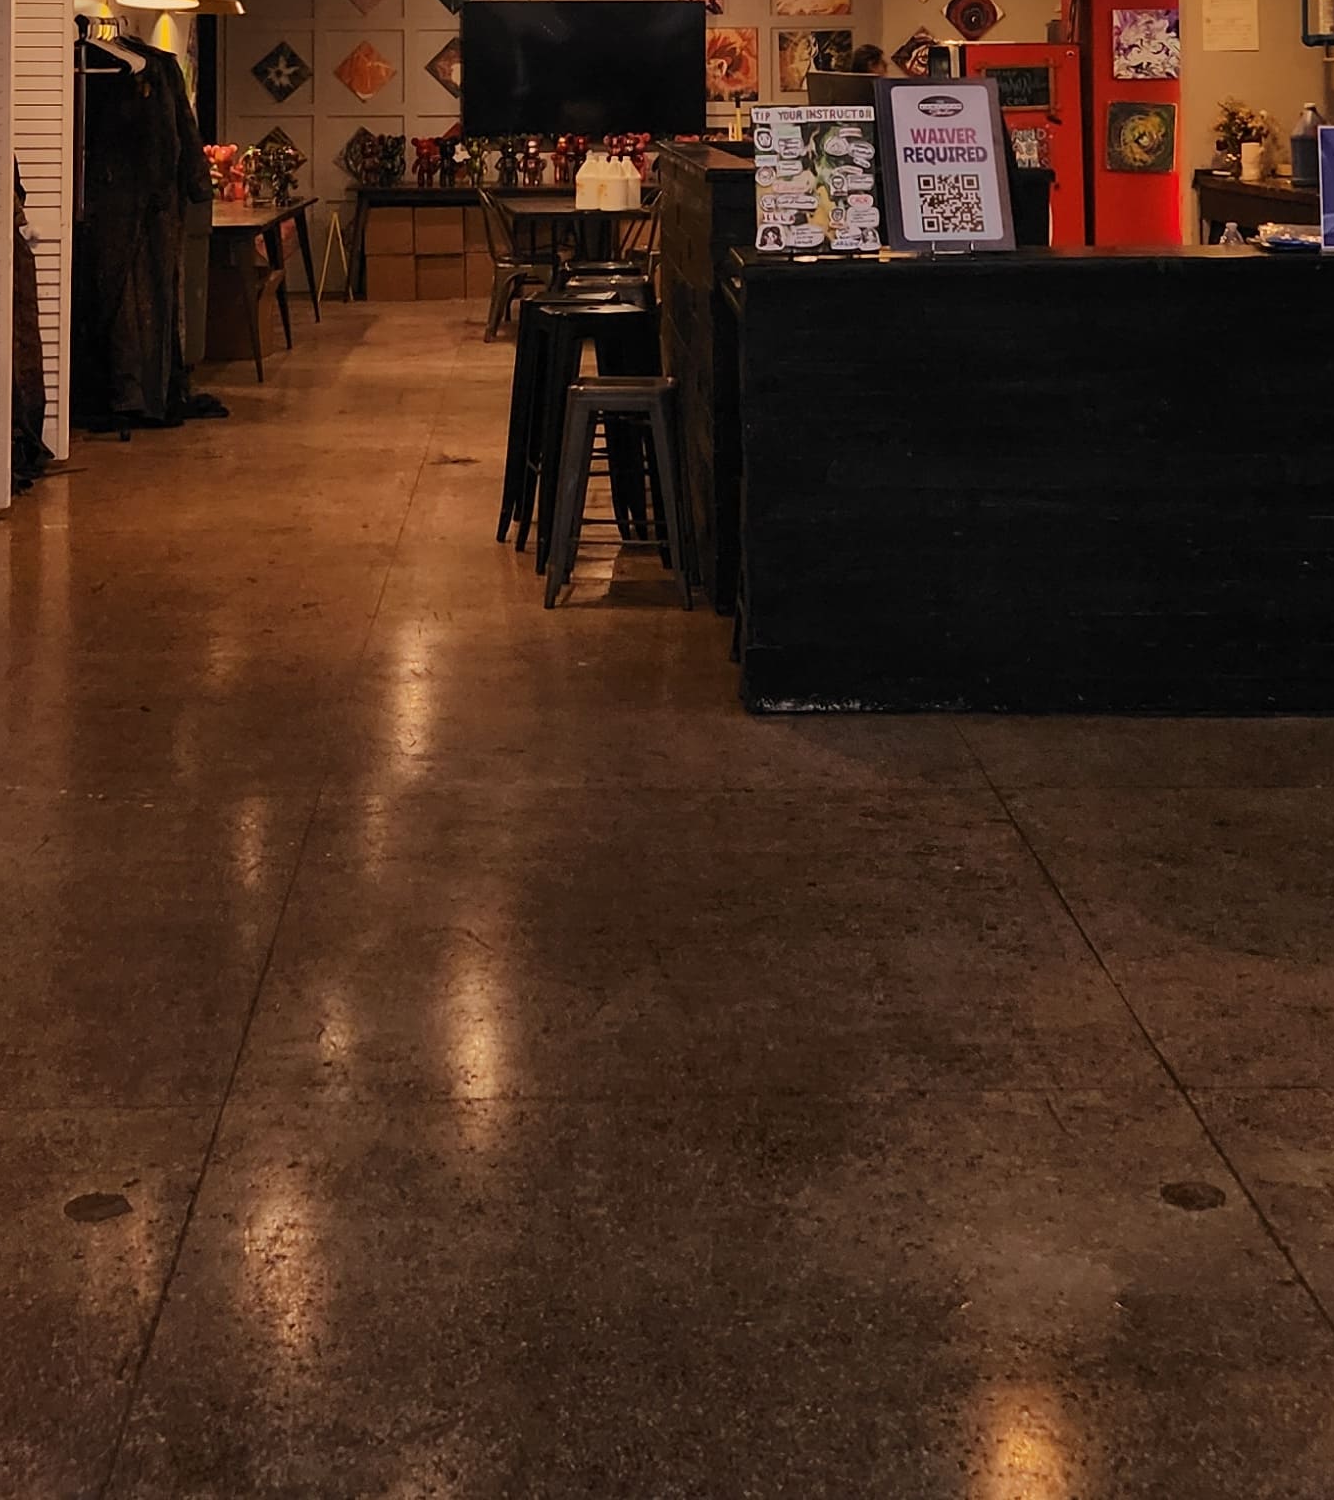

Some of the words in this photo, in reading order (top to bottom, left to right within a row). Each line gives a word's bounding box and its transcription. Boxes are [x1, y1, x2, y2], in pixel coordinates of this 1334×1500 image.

[779, 111, 802, 121] YOUR
[910, 128, 977, 145] WAIVER
[903, 147, 988, 165] REQUIRED
